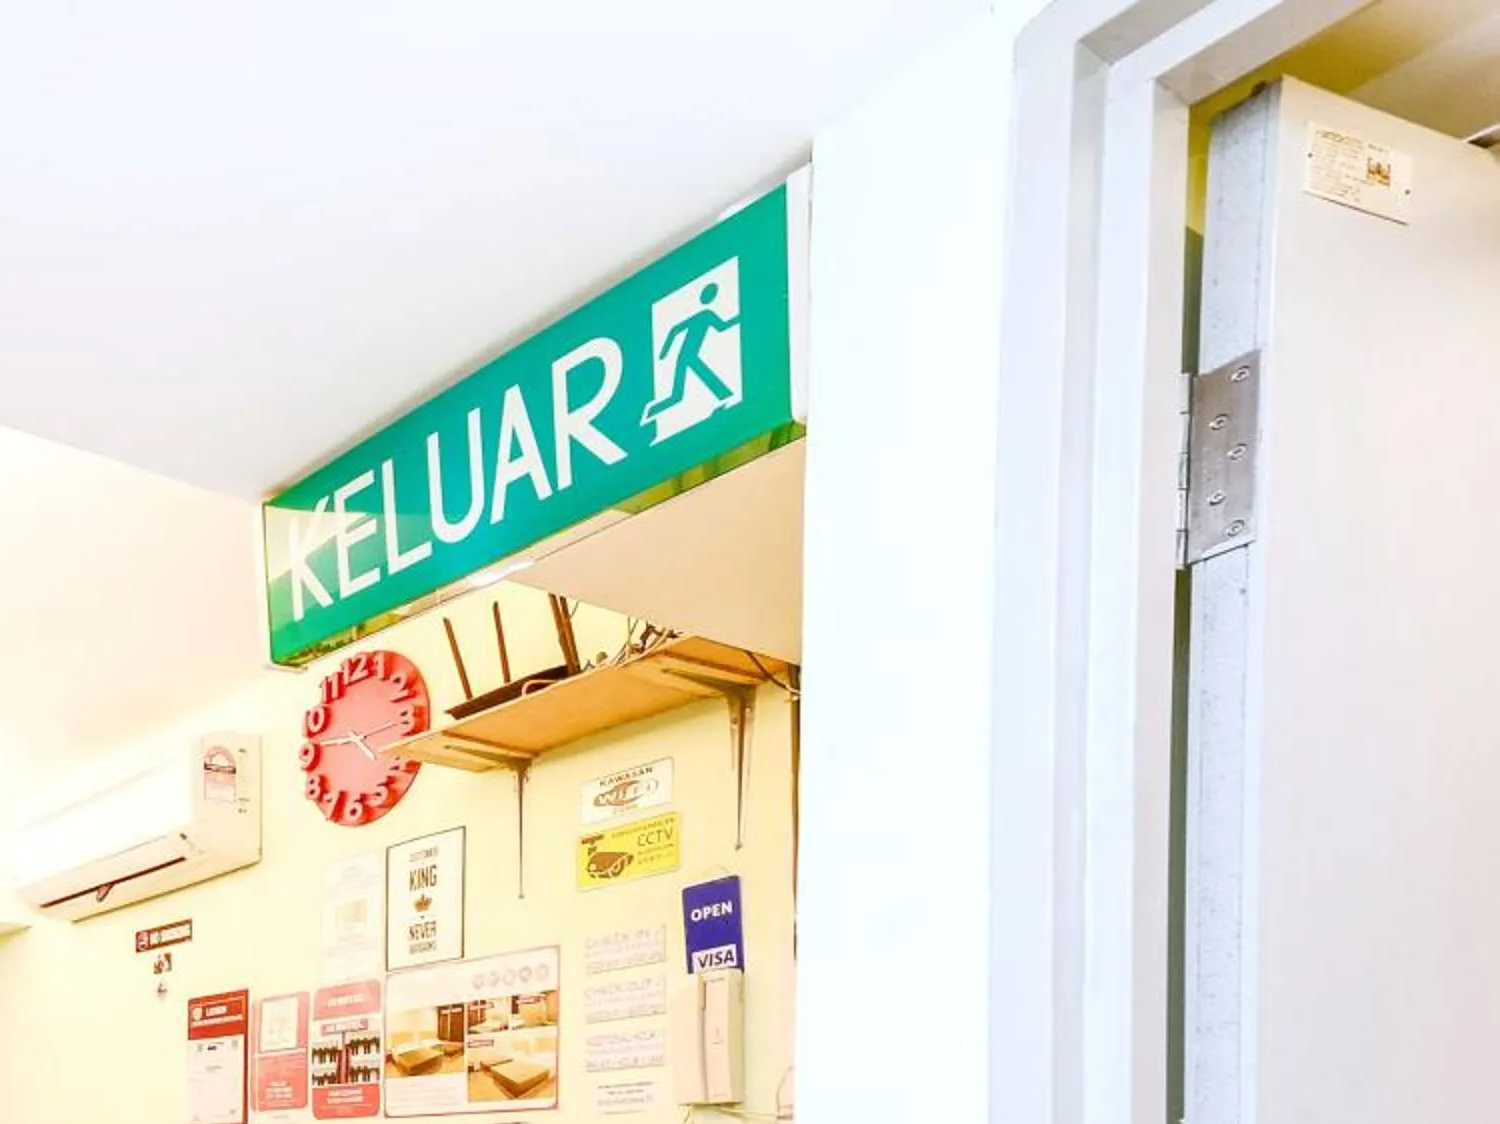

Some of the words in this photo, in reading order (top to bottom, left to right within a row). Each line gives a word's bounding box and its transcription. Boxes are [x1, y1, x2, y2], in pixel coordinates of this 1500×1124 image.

[288, 336, 629, 622] KELUAR
[341, 654, 369, 685] 12
[389, 671, 409, 702] 2
[637, 826, 675, 847] CCTV
[408, 863, 438, 892] KING
[691, 900, 733, 922] OPEN
[697, 949, 736, 968] VISA
